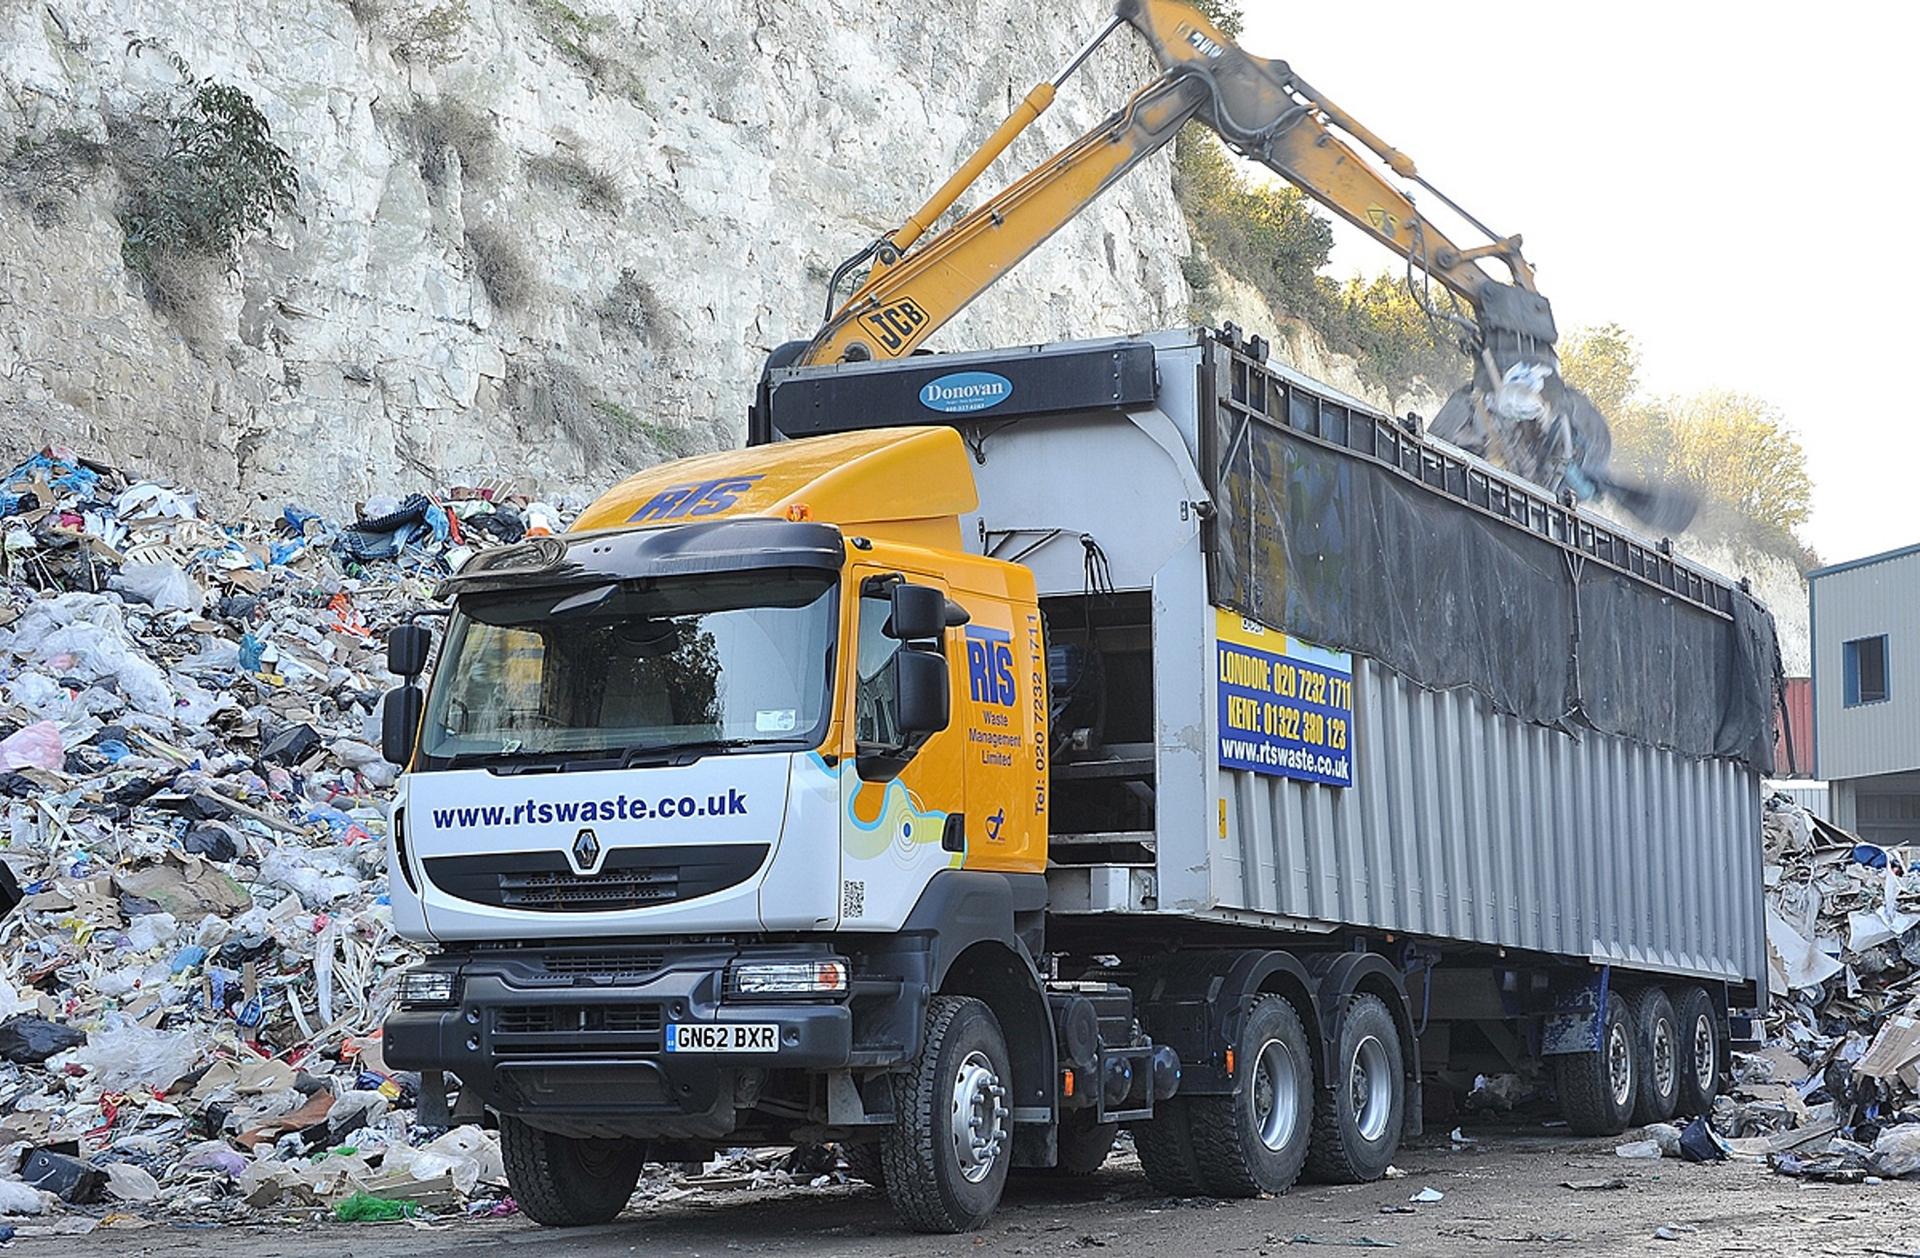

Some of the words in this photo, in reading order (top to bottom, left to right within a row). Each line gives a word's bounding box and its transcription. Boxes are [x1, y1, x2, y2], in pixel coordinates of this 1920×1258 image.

[867, 302, 924, 350] JCB
[927, 382, 1004, 401] Donovan
[626, 474, 767, 523] RTS
[1027, 614, 1041, 663] 1711
[965, 624, 1016, 707] RTS
[1219, 649, 1271, 693] LONDON:
[1274, 663, 1296, 698] 020
[1299, 669, 1326, 705] 7232
[1328, 677, 1351, 711] 1711
[983, 710, 1008, 727] Waste
[1031, 672, 1045, 727] 7232
[968, 728, 1022, 748] Management
[1227, 695, 1261, 733] KENT:
[1264, 702, 1300, 741] 01322
[1302, 711, 1324, 746] 380
[1327, 717, 1346, 751] 123
[981, 750, 1012, 767] Limited
[1034, 731, 1046, 771] 020
[1221, 738, 1350, 780] www.rtswaste.co.uk
[433, 788, 747, 828] www.rtswaste.co.uk
[1034, 779, 1046, 816] Tel:
[678, 1027, 729, 1048] GN62
[734, 1027, 775, 1048] BXR
